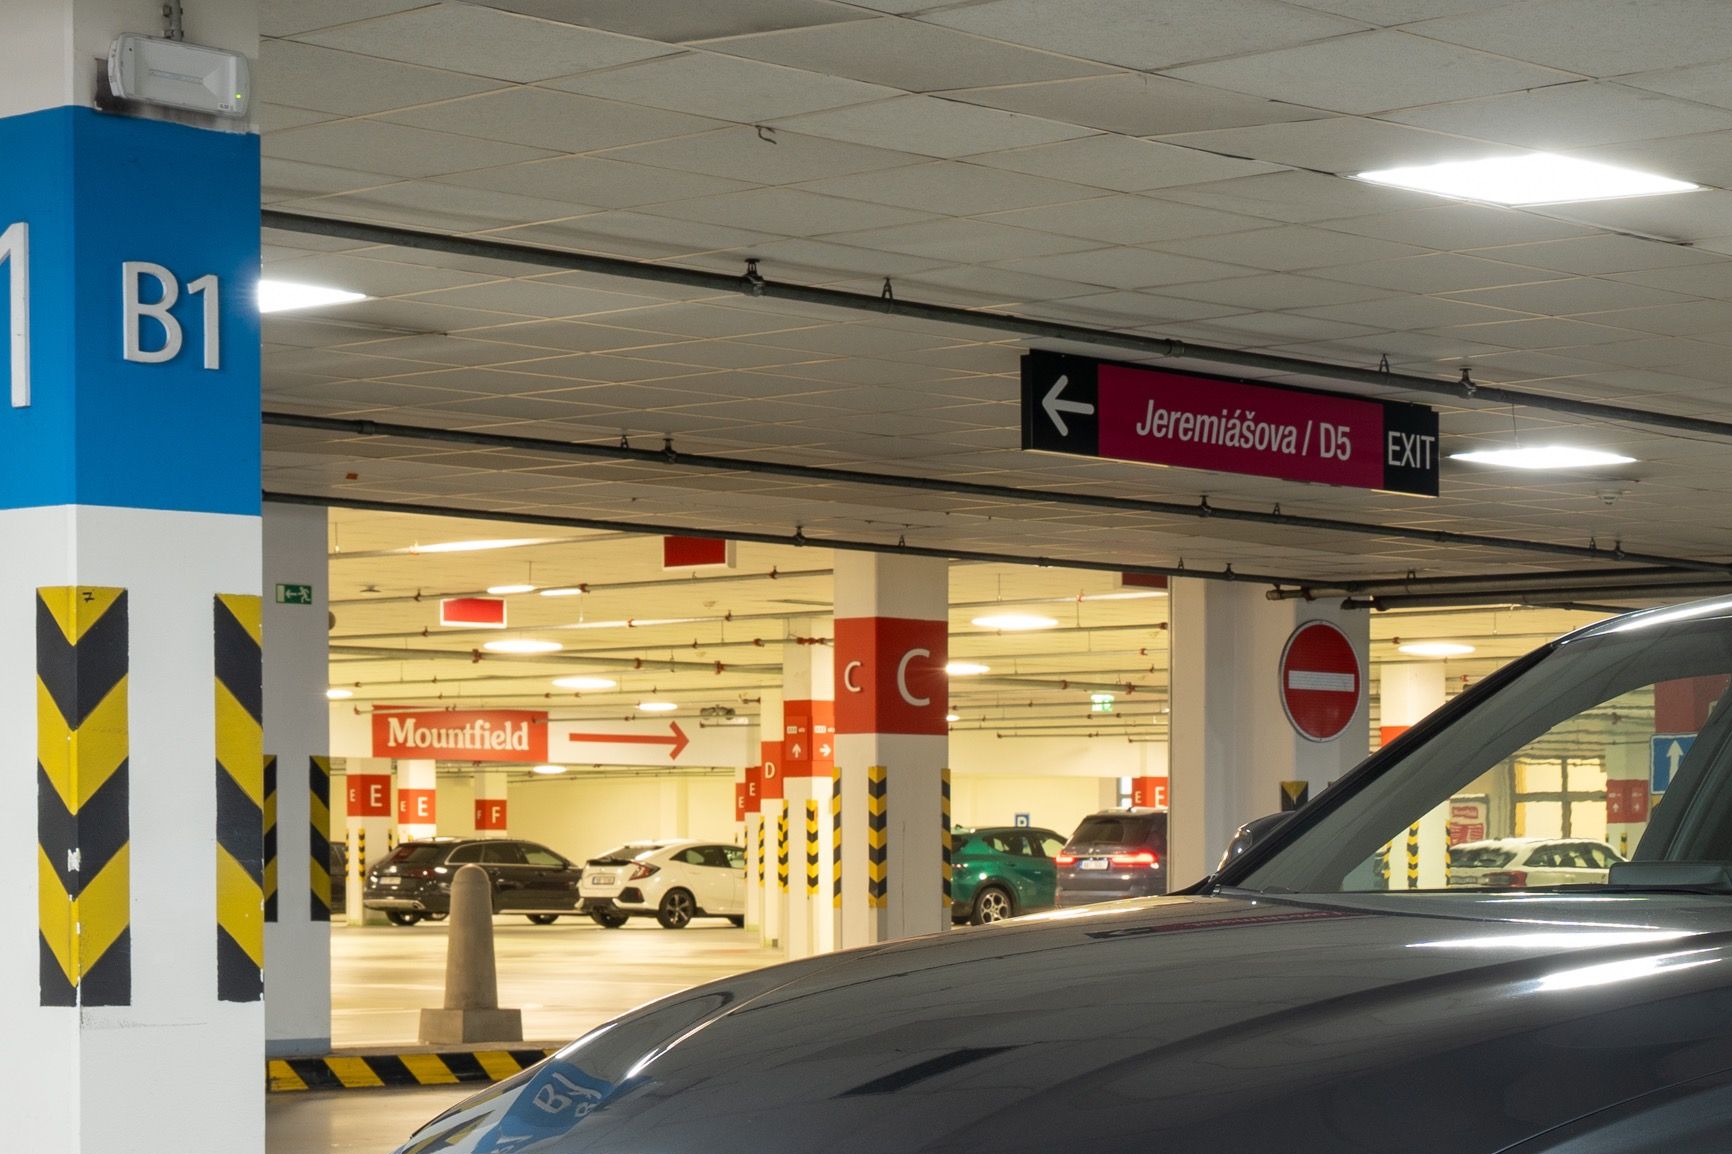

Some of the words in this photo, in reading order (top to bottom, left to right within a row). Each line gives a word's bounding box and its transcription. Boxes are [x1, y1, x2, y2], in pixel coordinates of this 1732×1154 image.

[122, 260, 222, 371] B1
[1136, 399, 1296, 455] Jeremiášova
[1319, 422, 1351, 461] D5
[1387, 430, 1435, 470] EXIT
[844, 660, 862, 693] C
[897, 648, 931, 707] C
[387, 717, 530, 751] Mountfield
[764, 761, 776, 779] D
[350, 788, 356, 803] E
[370, 784, 383, 808] E
[749, 782, 756, 796] E
[1134, 791, 1142, 804] E
[1154, 786, 1166, 809] E
[400, 800, 407, 813] E
[417, 796, 429, 817] E
[491, 806, 501, 824] F
